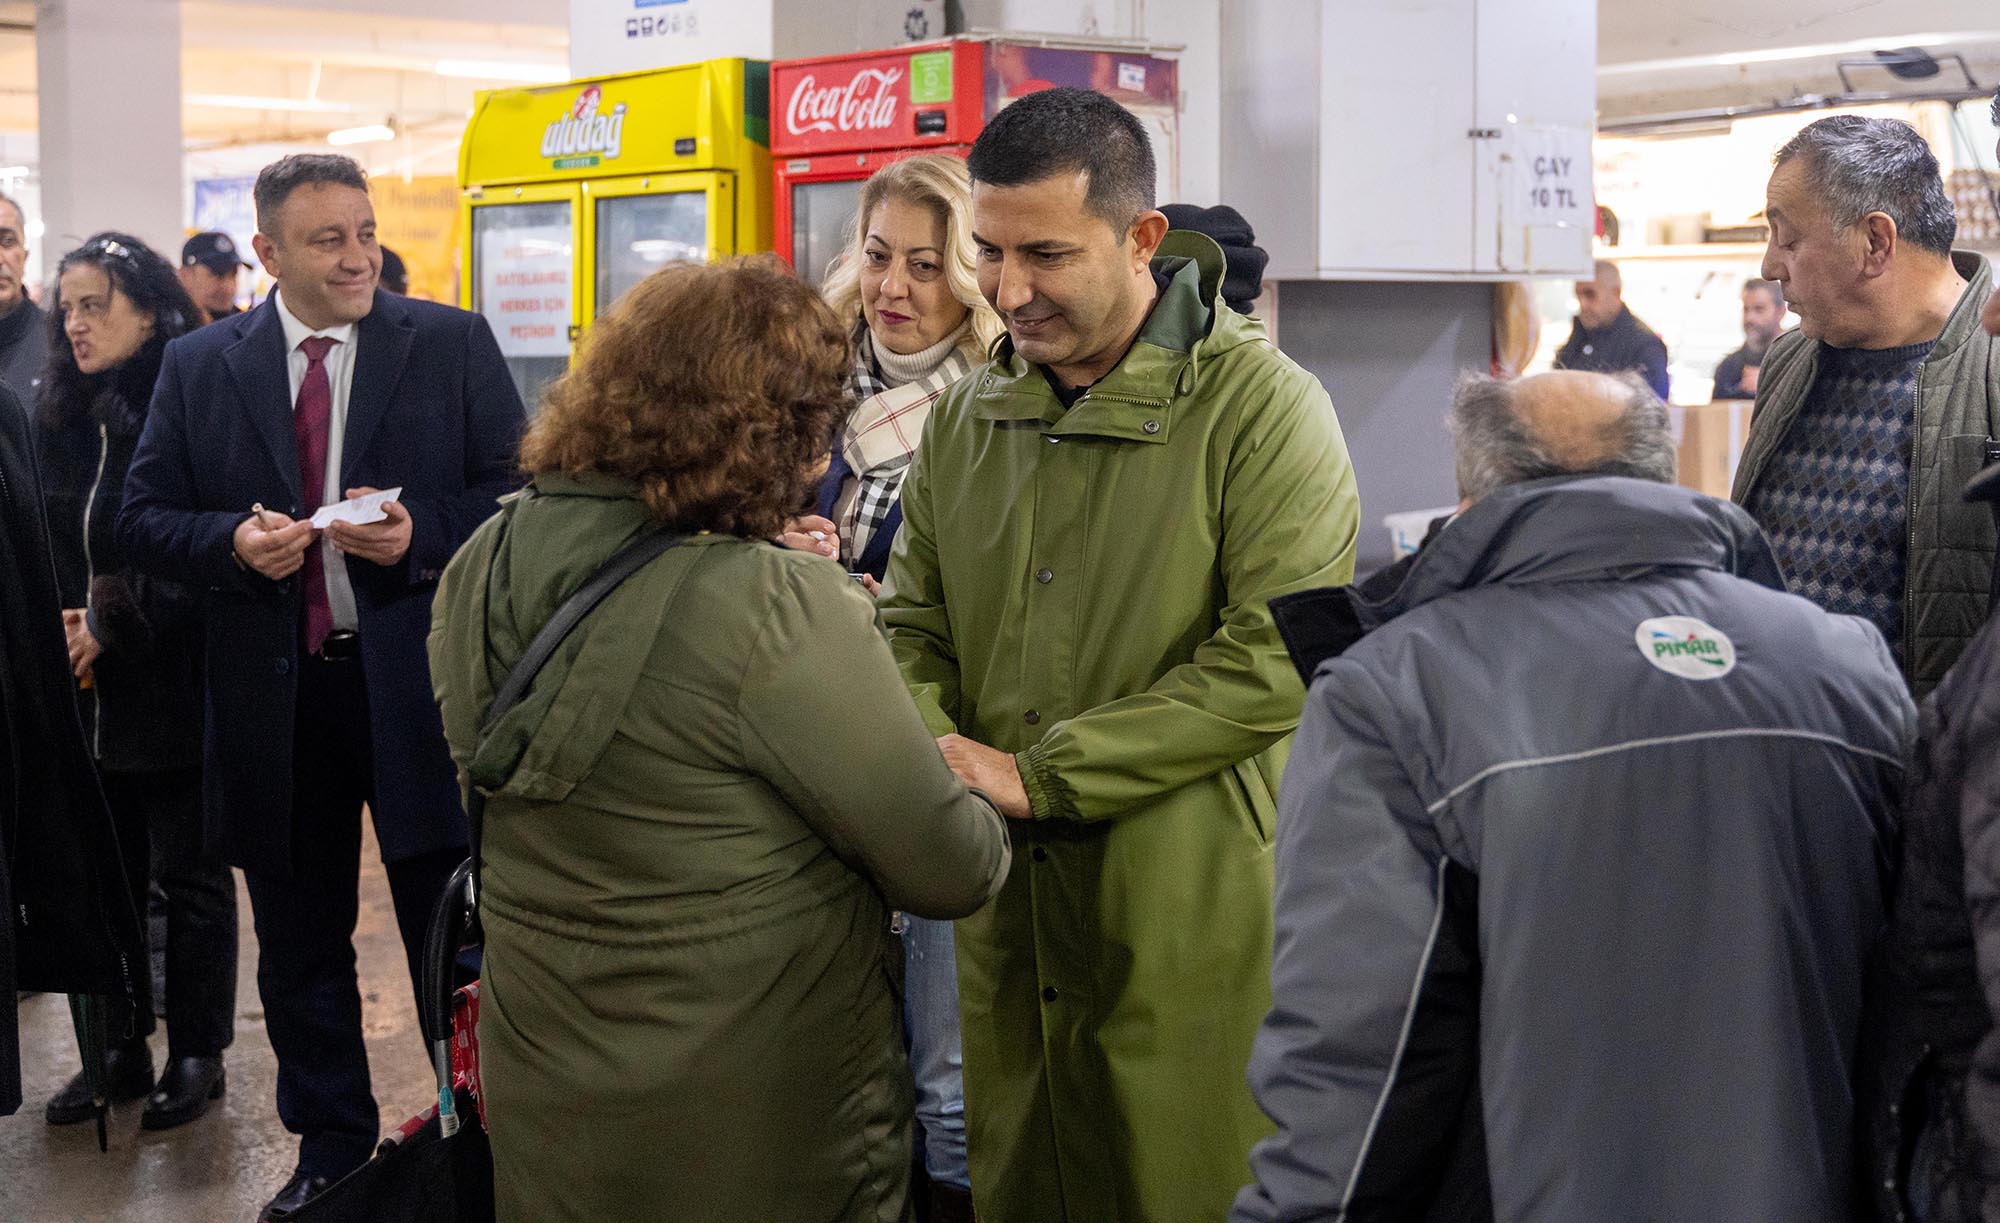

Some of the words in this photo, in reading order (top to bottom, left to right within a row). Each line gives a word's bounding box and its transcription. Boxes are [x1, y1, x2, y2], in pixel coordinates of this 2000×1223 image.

[786, 67, 903, 135] Coca-Cola
[1534, 155, 1572, 181] ÇAY
[1531, 188, 1549, 208] 10
[1556, 188, 1577, 208] TL
